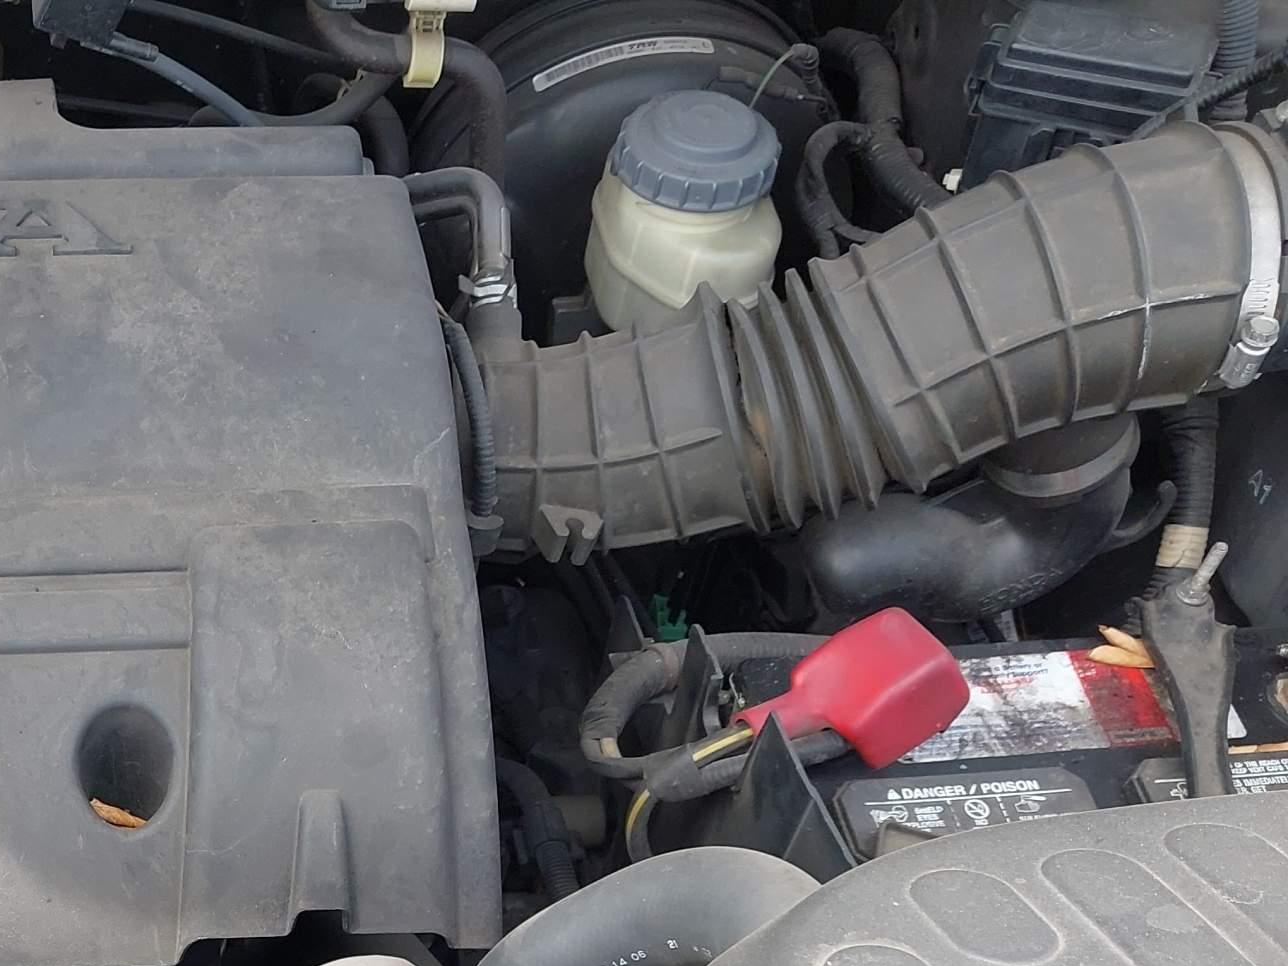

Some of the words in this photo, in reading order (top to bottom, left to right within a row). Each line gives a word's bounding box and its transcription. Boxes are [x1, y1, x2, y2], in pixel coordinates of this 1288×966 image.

[1243, 775, 1288, 786] IMMEDIATEL
[901, 784, 966, 800] DANGER
[969, 783, 977, 794] /
[980, 780, 1040, 793] POISON
